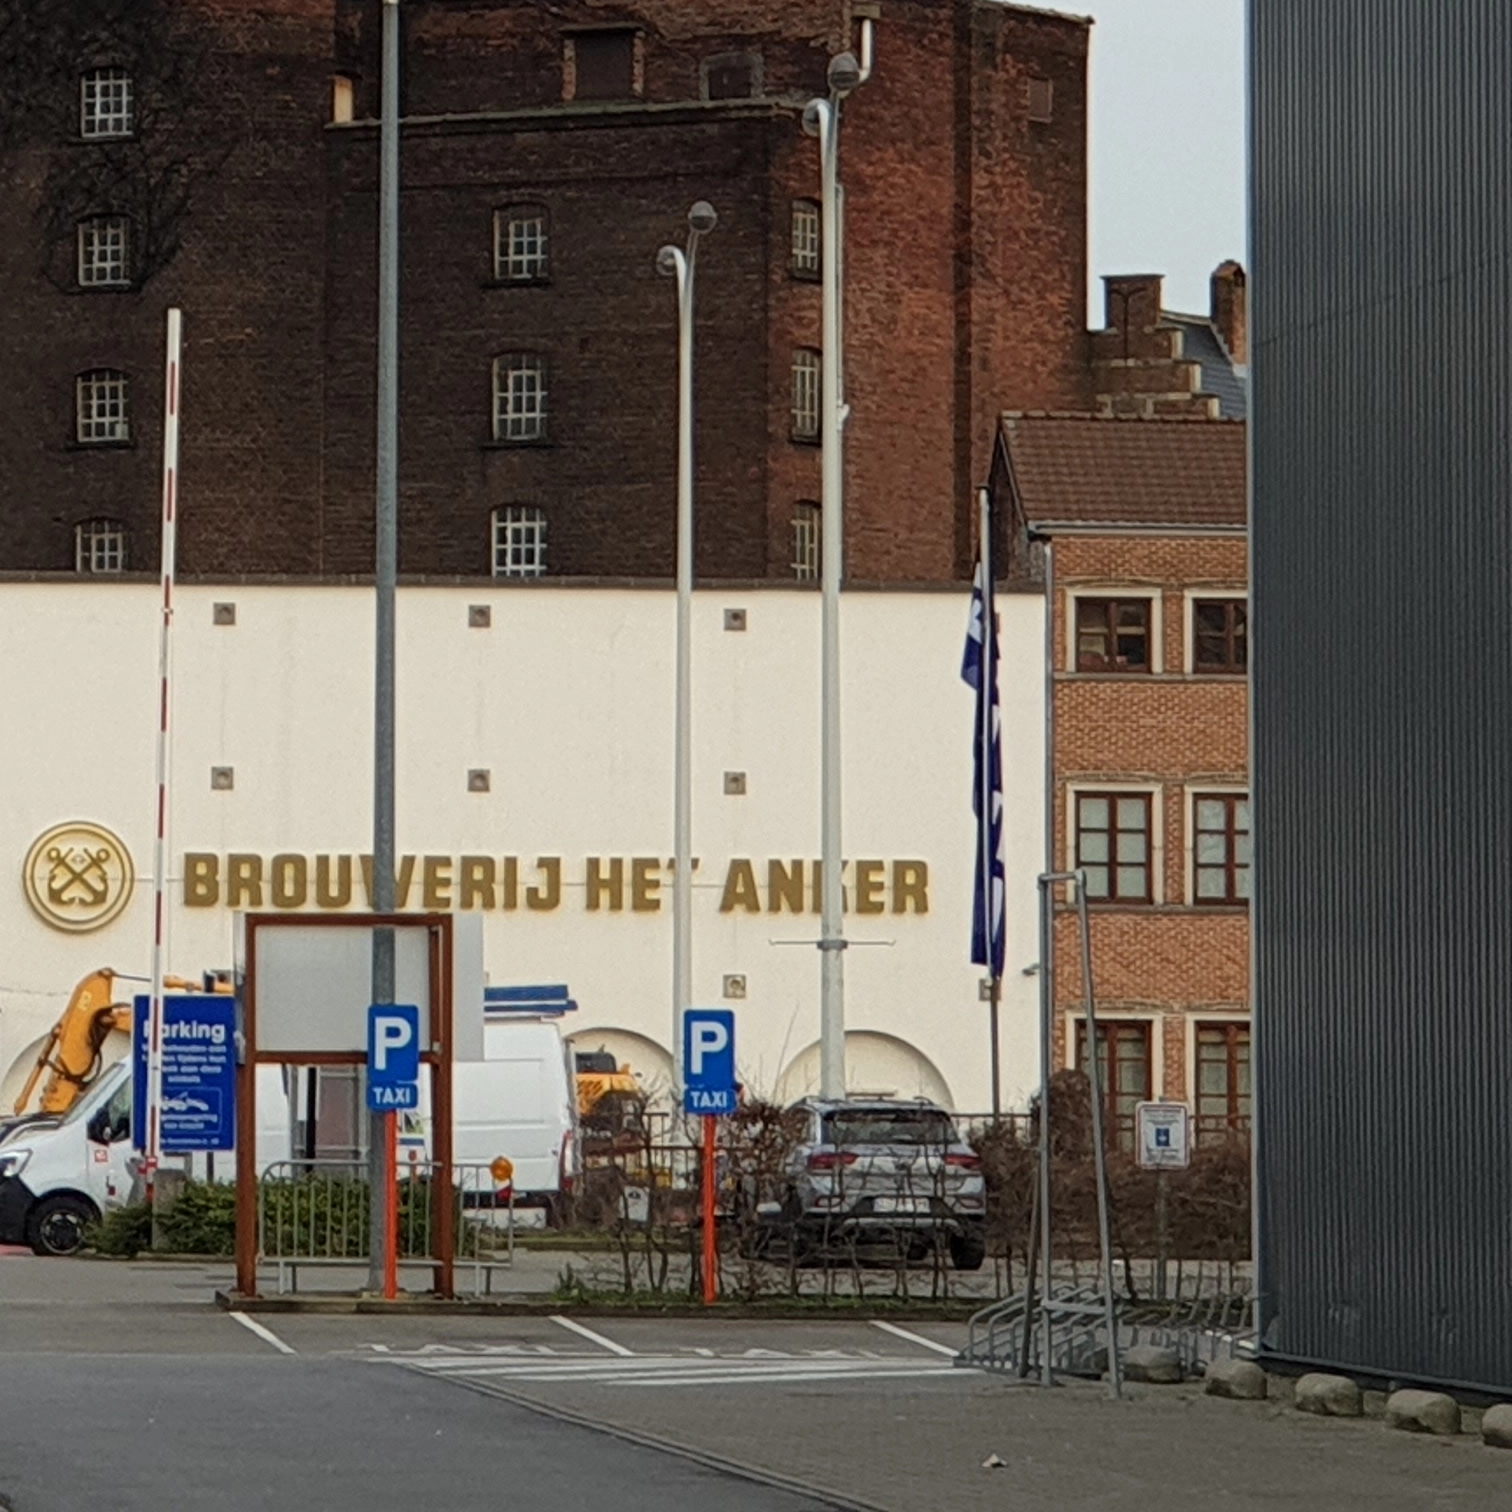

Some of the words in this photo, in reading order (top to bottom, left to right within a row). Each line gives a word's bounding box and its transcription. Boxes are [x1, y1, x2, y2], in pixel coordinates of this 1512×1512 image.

[183, 852, 562, 910] BROUWERIJ
[586, 856, 701, 913] HE
[374, 1016, 412, 1070] P
[691, 1021, 728, 1075] P
[372, 1087, 411, 1105] TAXI
[690, 1091, 728, 1109] TAXI
